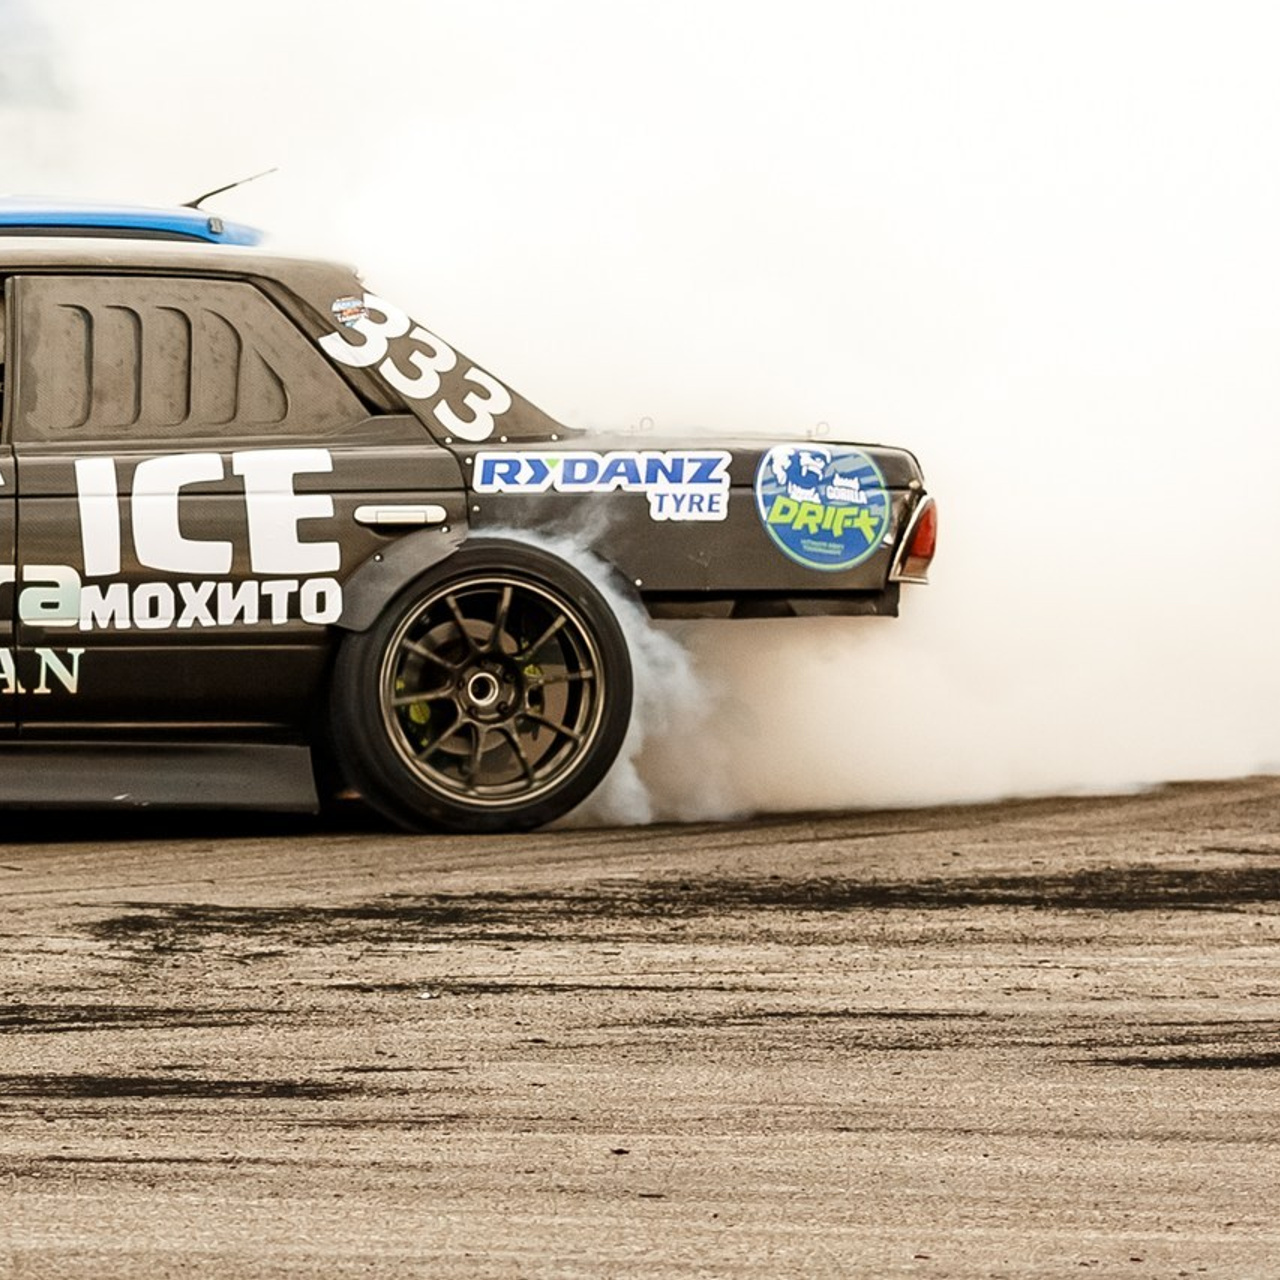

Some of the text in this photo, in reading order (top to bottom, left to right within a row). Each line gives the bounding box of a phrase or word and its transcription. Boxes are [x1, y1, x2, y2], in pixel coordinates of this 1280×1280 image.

[318, 292, 512, 442] 333
[480, 457, 724, 485] RYDANZ
[74, 448, 341, 577] ICE
[655, 493, 722, 513] TYRE
[768, 495, 880, 545] DRIFT
[79, 577, 343, 631] МОХИТО
